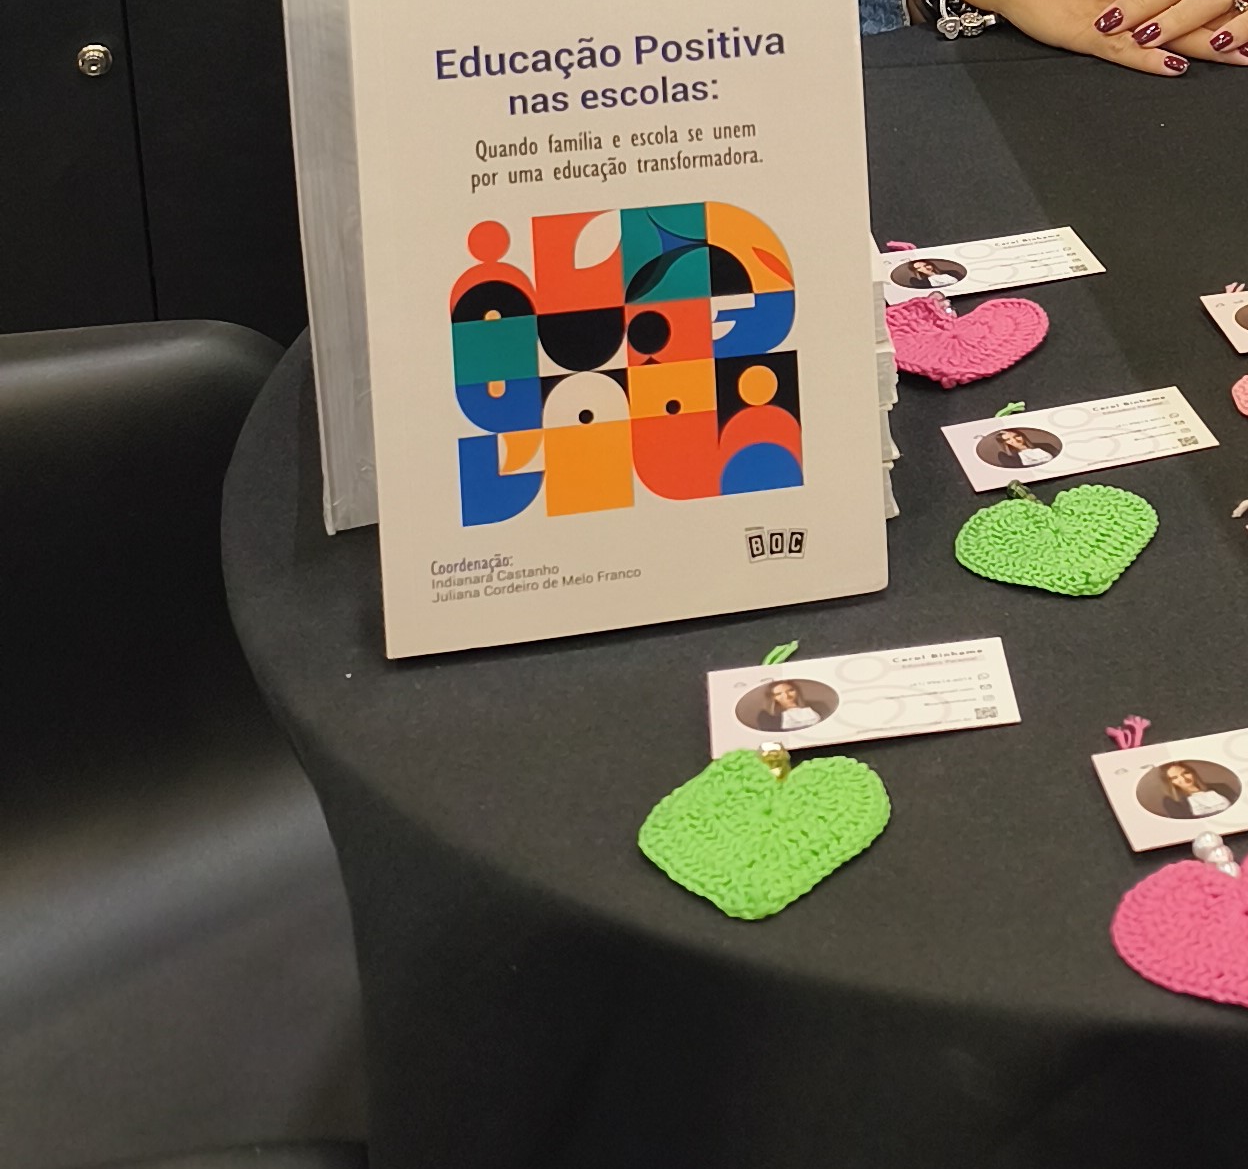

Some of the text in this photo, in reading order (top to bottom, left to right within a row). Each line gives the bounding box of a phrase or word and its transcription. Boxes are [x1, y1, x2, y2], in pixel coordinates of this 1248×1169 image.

[435, 27, 785, 80] Educação Positiva
[509, 76, 719, 115] nas escolas:
[475, 123, 757, 162] Quando família e escola se unem
[471, 147, 764, 194] por uma educação transformadora.
[748, 531, 805, 559] BOC
[430, 553, 513, 576] Coordenação:
[496, 564, 560, 581] Castanho
[431, 568, 642, 603] Juliana Cordeiro de Melo Franco
